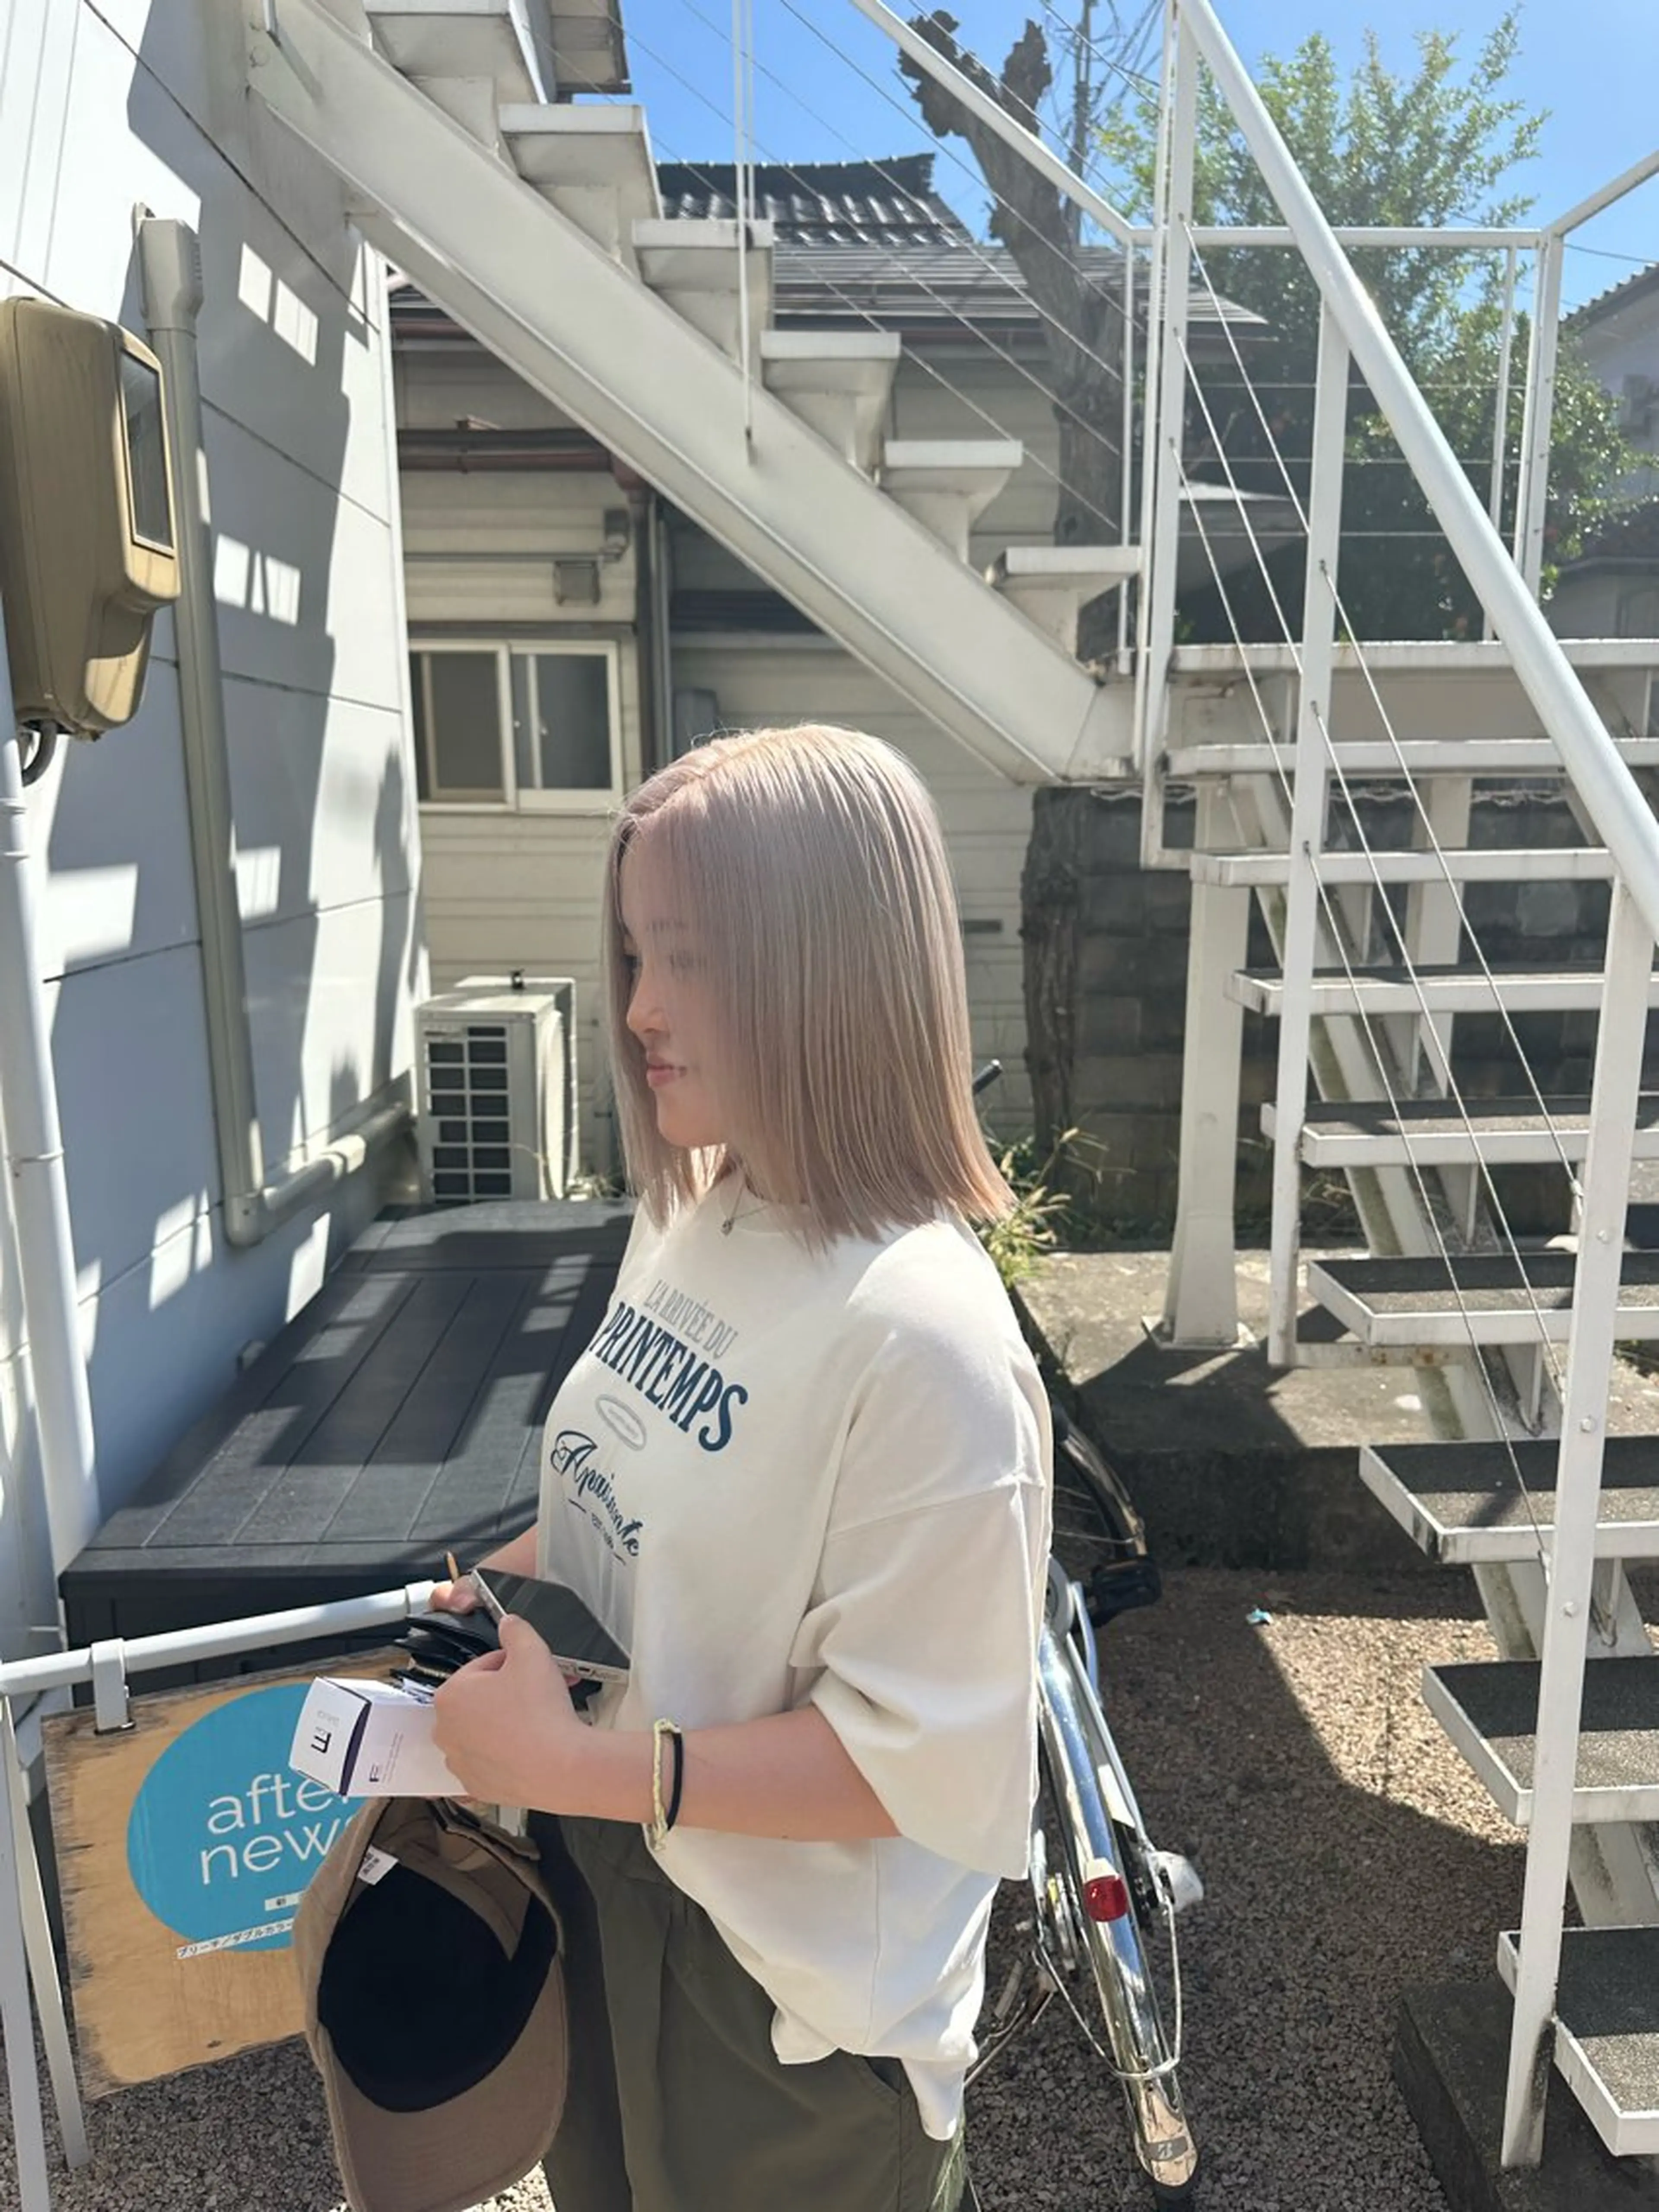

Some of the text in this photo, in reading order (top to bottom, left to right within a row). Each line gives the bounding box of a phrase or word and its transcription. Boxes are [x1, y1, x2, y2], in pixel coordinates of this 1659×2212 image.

[644, 1279, 738, 1360] L'ARRIVÉE DU
[589, 1301, 749, 1452] PRINTEMPS
[207, 1773, 348, 1835] afte
[200, 1816, 353, 1885] new
